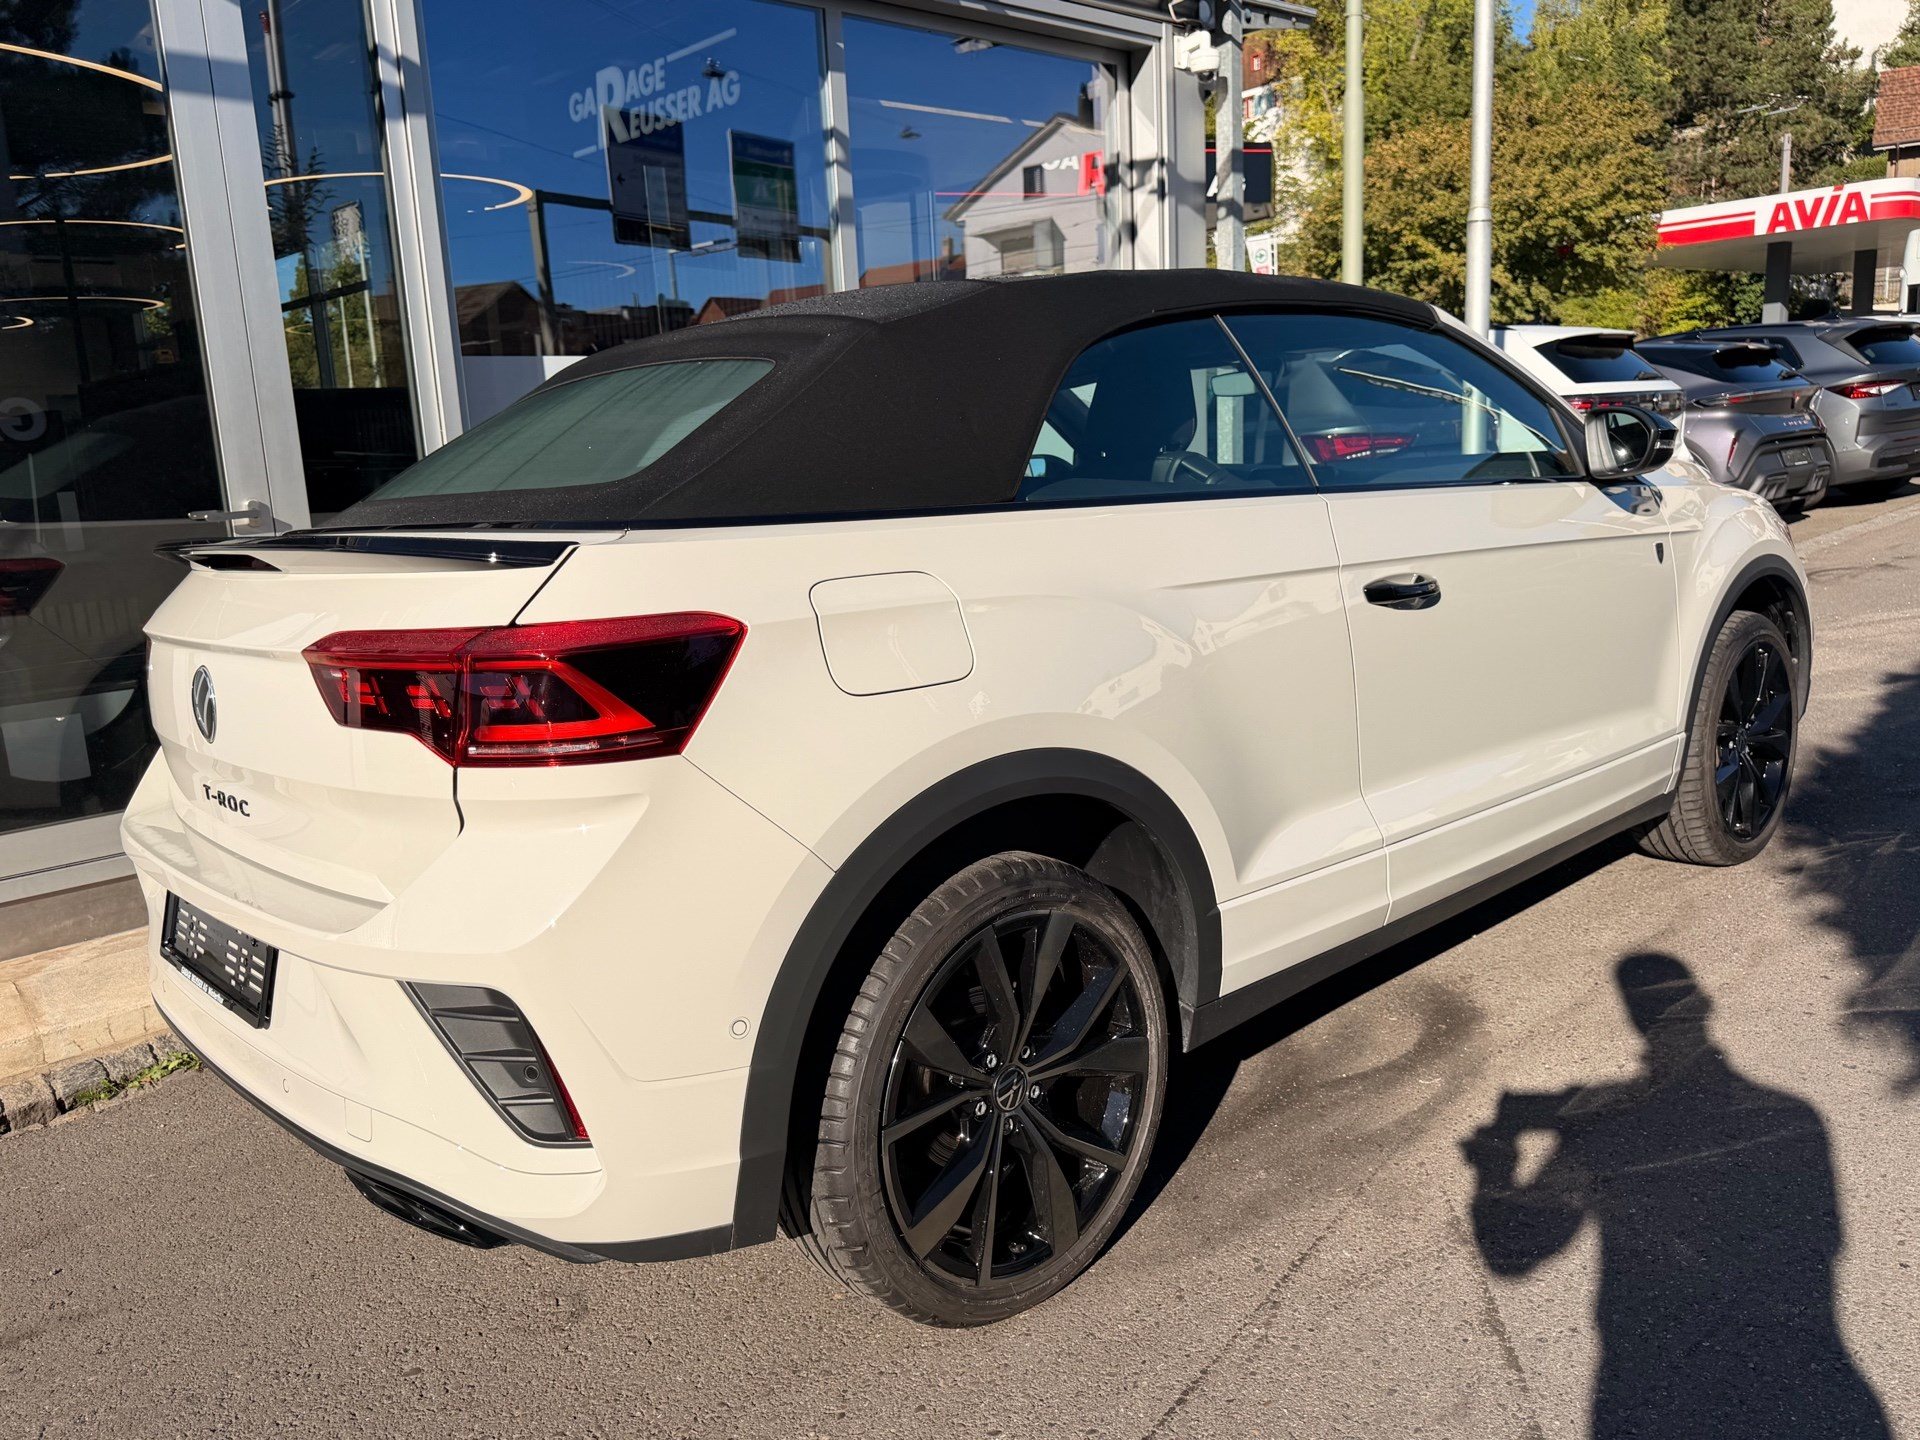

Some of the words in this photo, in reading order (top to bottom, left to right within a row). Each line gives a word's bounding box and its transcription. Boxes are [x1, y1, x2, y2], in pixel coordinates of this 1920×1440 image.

[568, 57, 667, 149] GARAGE
[596, 66, 703, 149] REUSSER
[706, 70, 742, 113] AG
[1766, 184, 1869, 234] AVIA
[203, 784, 251, 817] T-ROC
